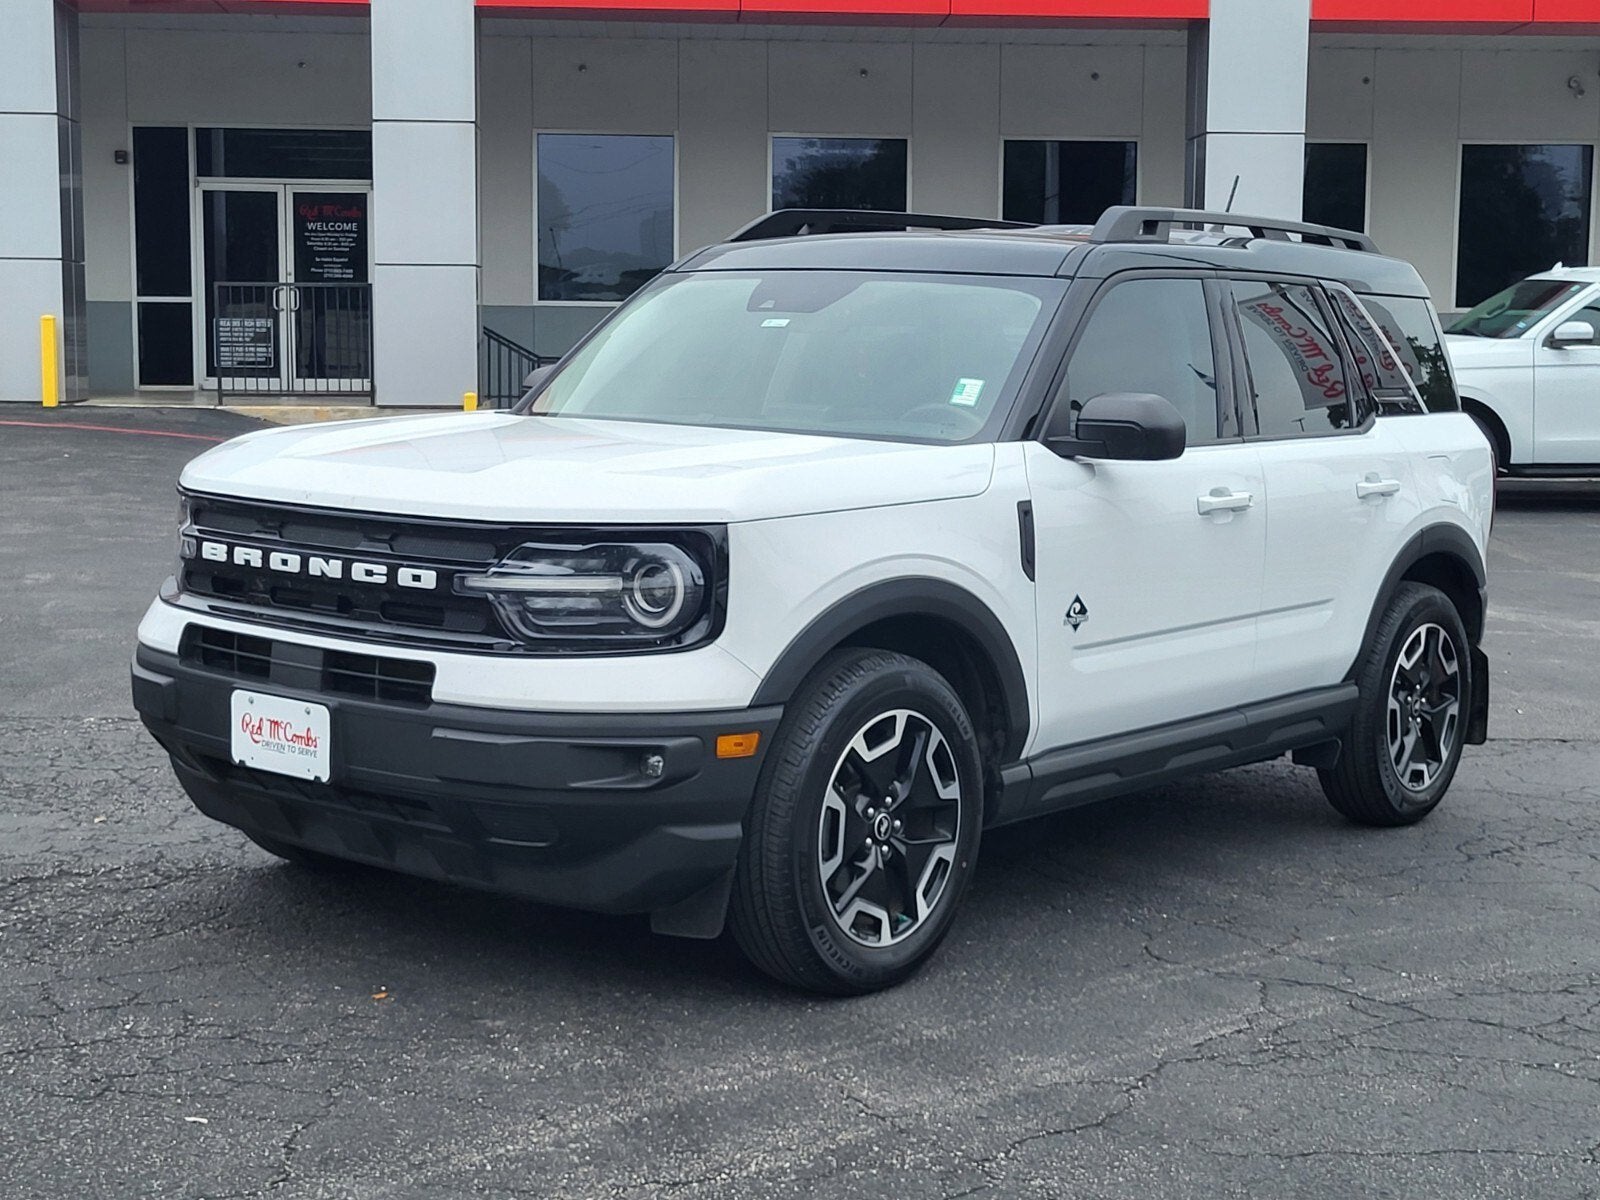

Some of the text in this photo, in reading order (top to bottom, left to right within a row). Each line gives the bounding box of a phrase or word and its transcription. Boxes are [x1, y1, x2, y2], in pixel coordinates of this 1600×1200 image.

[307, 221, 358, 231] WELCOME
[201, 541, 437, 590] BRONCO
[241, 712, 318, 748] Red McCombs
[261, 740, 318, 759] DRIVEN TO SERVE
